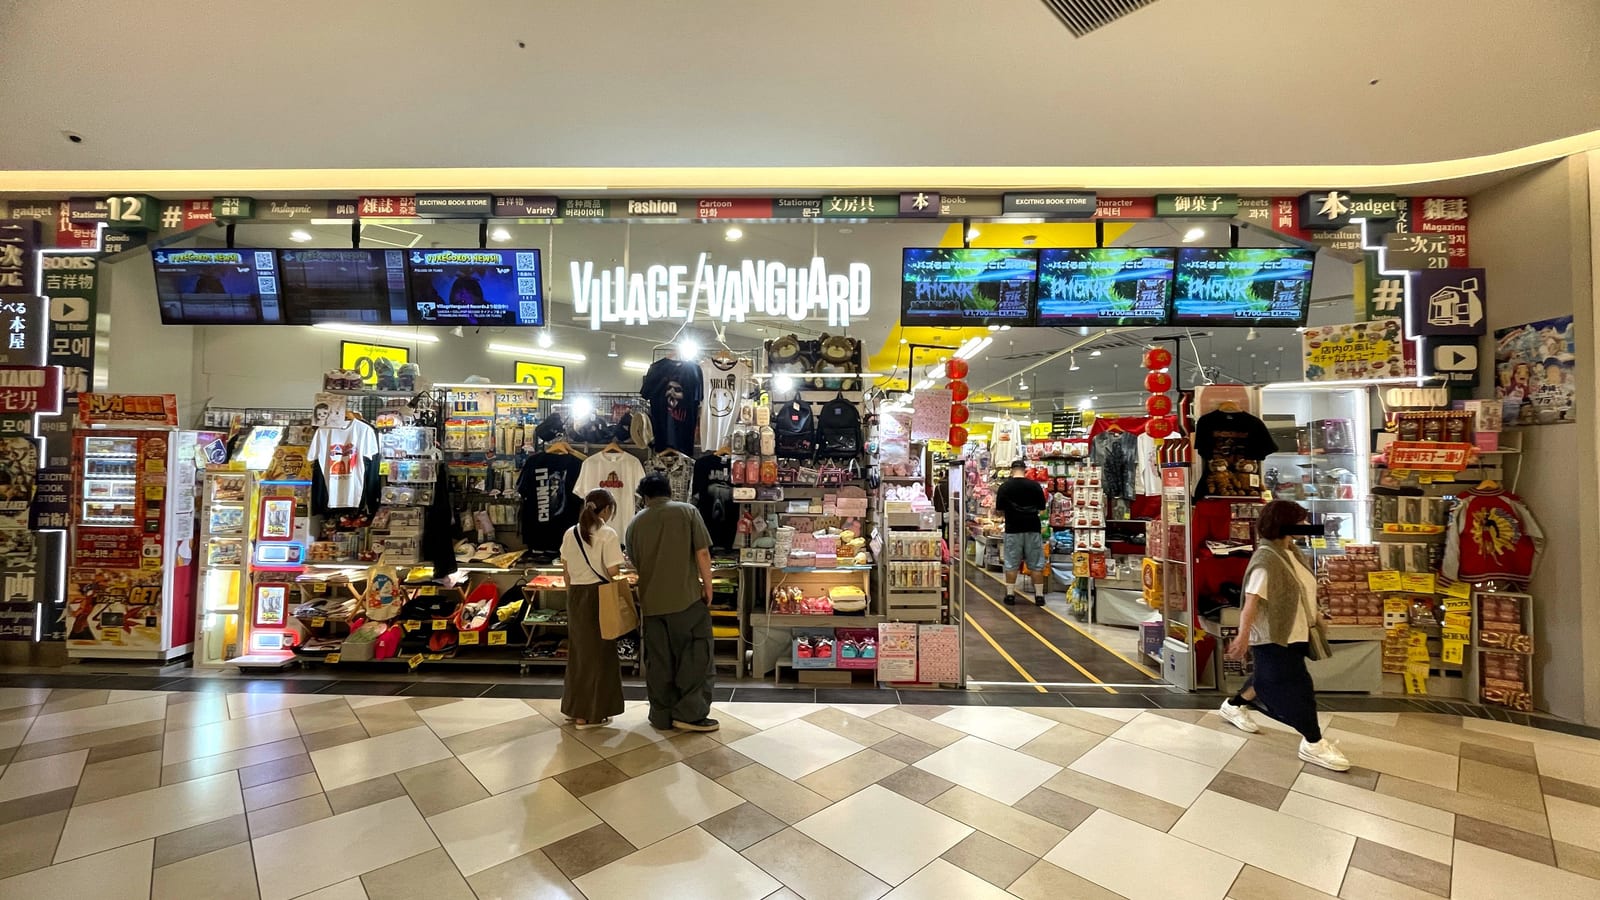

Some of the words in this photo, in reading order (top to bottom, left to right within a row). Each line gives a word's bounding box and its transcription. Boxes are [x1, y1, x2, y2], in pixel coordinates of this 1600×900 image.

[496, 198, 524, 206] 吉祥物
[628, 199, 678, 214] Fashion
[699, 200, 732, 208] Cartoon
[778, 199, 821, 208] Stationery
[827, 197, 875, 212] 文房具
[912, 192, 929, 210] 本
[941, 196, 966, 204] Books
[1174, 196, 1223, 212] 御菓子
[1238, 198, 1269, 207] Sweets
[1316, 191, 1350, 220] 本
[1349, 198, 1396, 215] gadget
[12, 205, 53, 220] gadget
[107, 196, 142, 221] 12
[188, 211, 216, 220] Sweet
[526, 206, 555, 216] Variety
[565, 208, 604, 216] 버라이어티
[699, 208, 718, 217] 만화
[802, 208, 821, 217] 문구
[1248, 208, 1269, 219] 과자
[1422, 223, 1466, 233] Magazine
[105, 234, 130, 242] Goods
[1313, 231, 1361, 240] subculture
[1391, 235, 1447, 253] 二次元
[42, 256, 96, 270] BOOKS
[1428, 256, 1448, 269] 2D
[46, 274, 93, 290] 吉祥物
[916, 277, 975, 300] PHONK
[1050, 277, 1110, 300] PHONK
[1188, 277, 1248, 300] PHONK
[9, 315, 26, 349] 本屋
[51, 337, 91, 358] 모에
[0, 369, 45, 387] TAKU
[2, 420, 31, 434] 모에
[38, 495, 67, 503] STORE
[534, 467, 550, 523] CHUN-LI
[129, 586, 160, 606] GET
